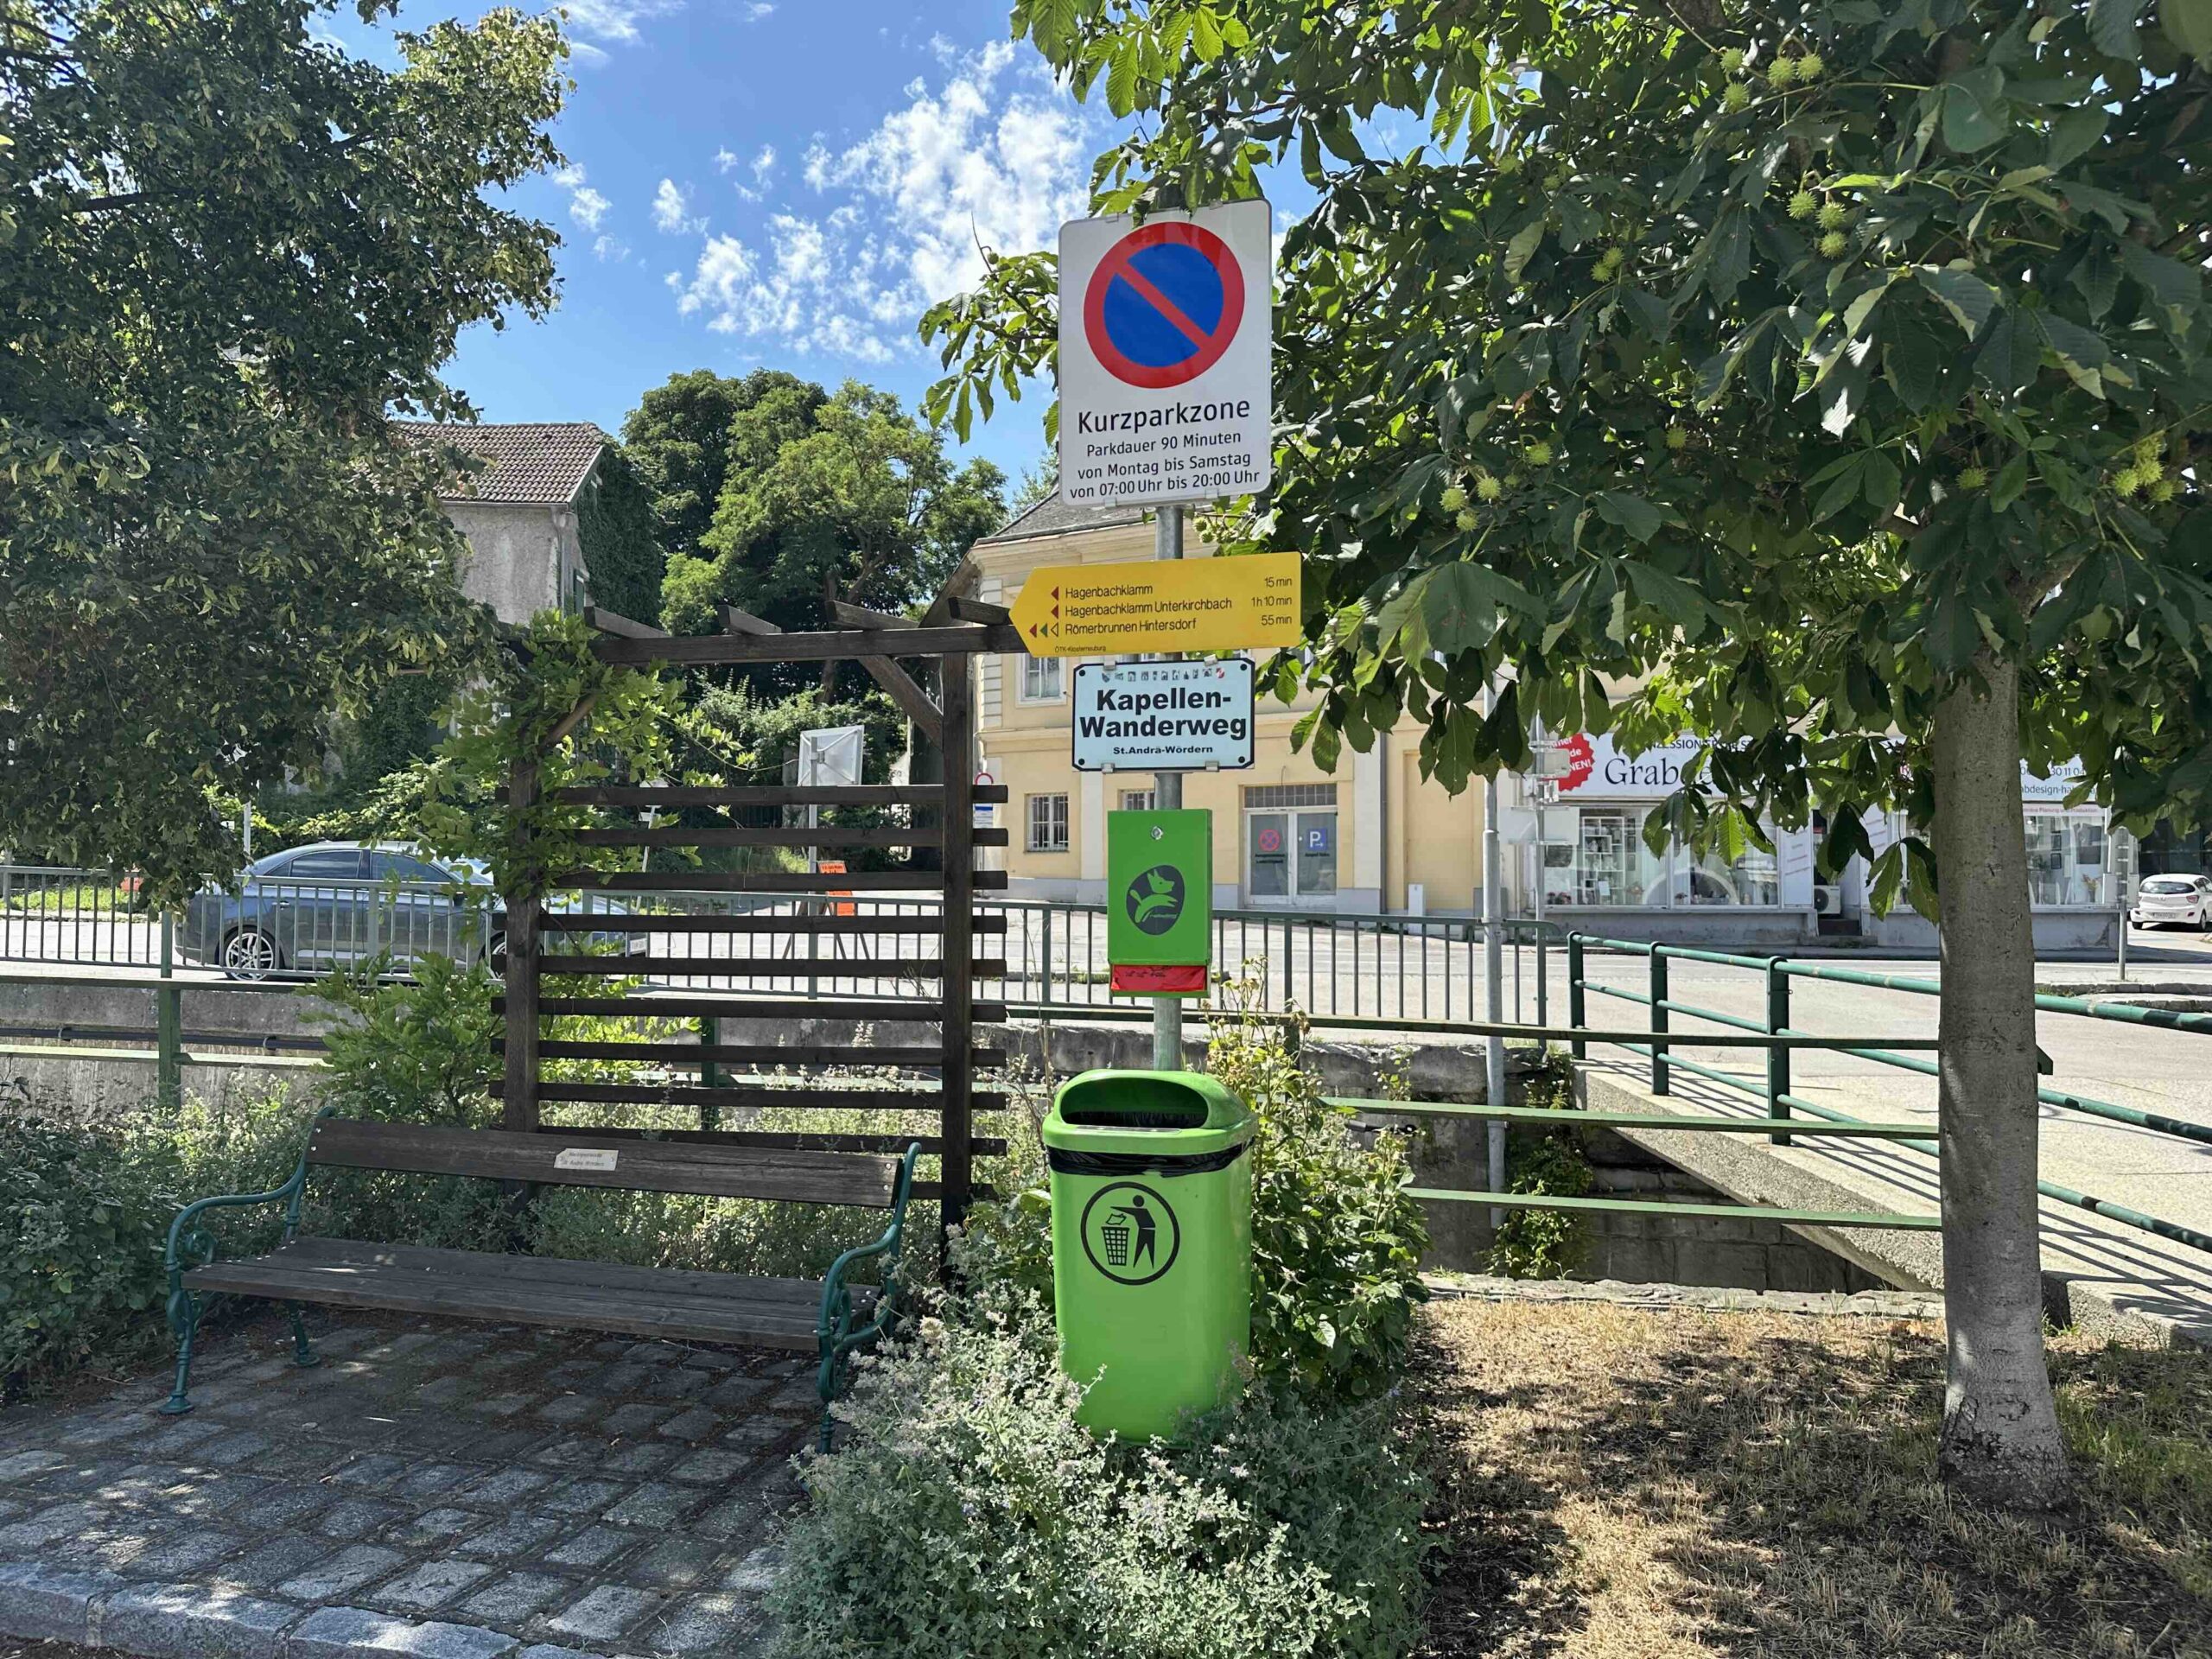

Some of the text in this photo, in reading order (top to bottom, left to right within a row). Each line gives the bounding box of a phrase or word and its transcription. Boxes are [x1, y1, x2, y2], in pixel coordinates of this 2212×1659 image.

[1078, 400, 1250, 434] Kurzparkzone
[1087, 432, 1241, 457] Parkdauer 90 Minuten
[1077, 454, 1250, 480] von Montag bis Samstag
[1070, 470, 1260, 499] von 07:00 Uhr bis 20:00 Uhr
[1065, 576, 1292, 600] Hagenbachklamm 15 min
[1065, 602, 1153, 618] Hagenbachklamm
[1154, 597, 1232, 613] Unterkirchbach
[1264, 596, 1274, 606] 10
[1275, 596, 1292, 606] min
[1065, 615, 1292, 635] Römerbrunnen Hintersdorf 55 min
[1097, 688, 1231, 715] Kapellen-
[1079, 715, 1246, 741] Wanderweg
[1309, 830, 1321, 848] P
